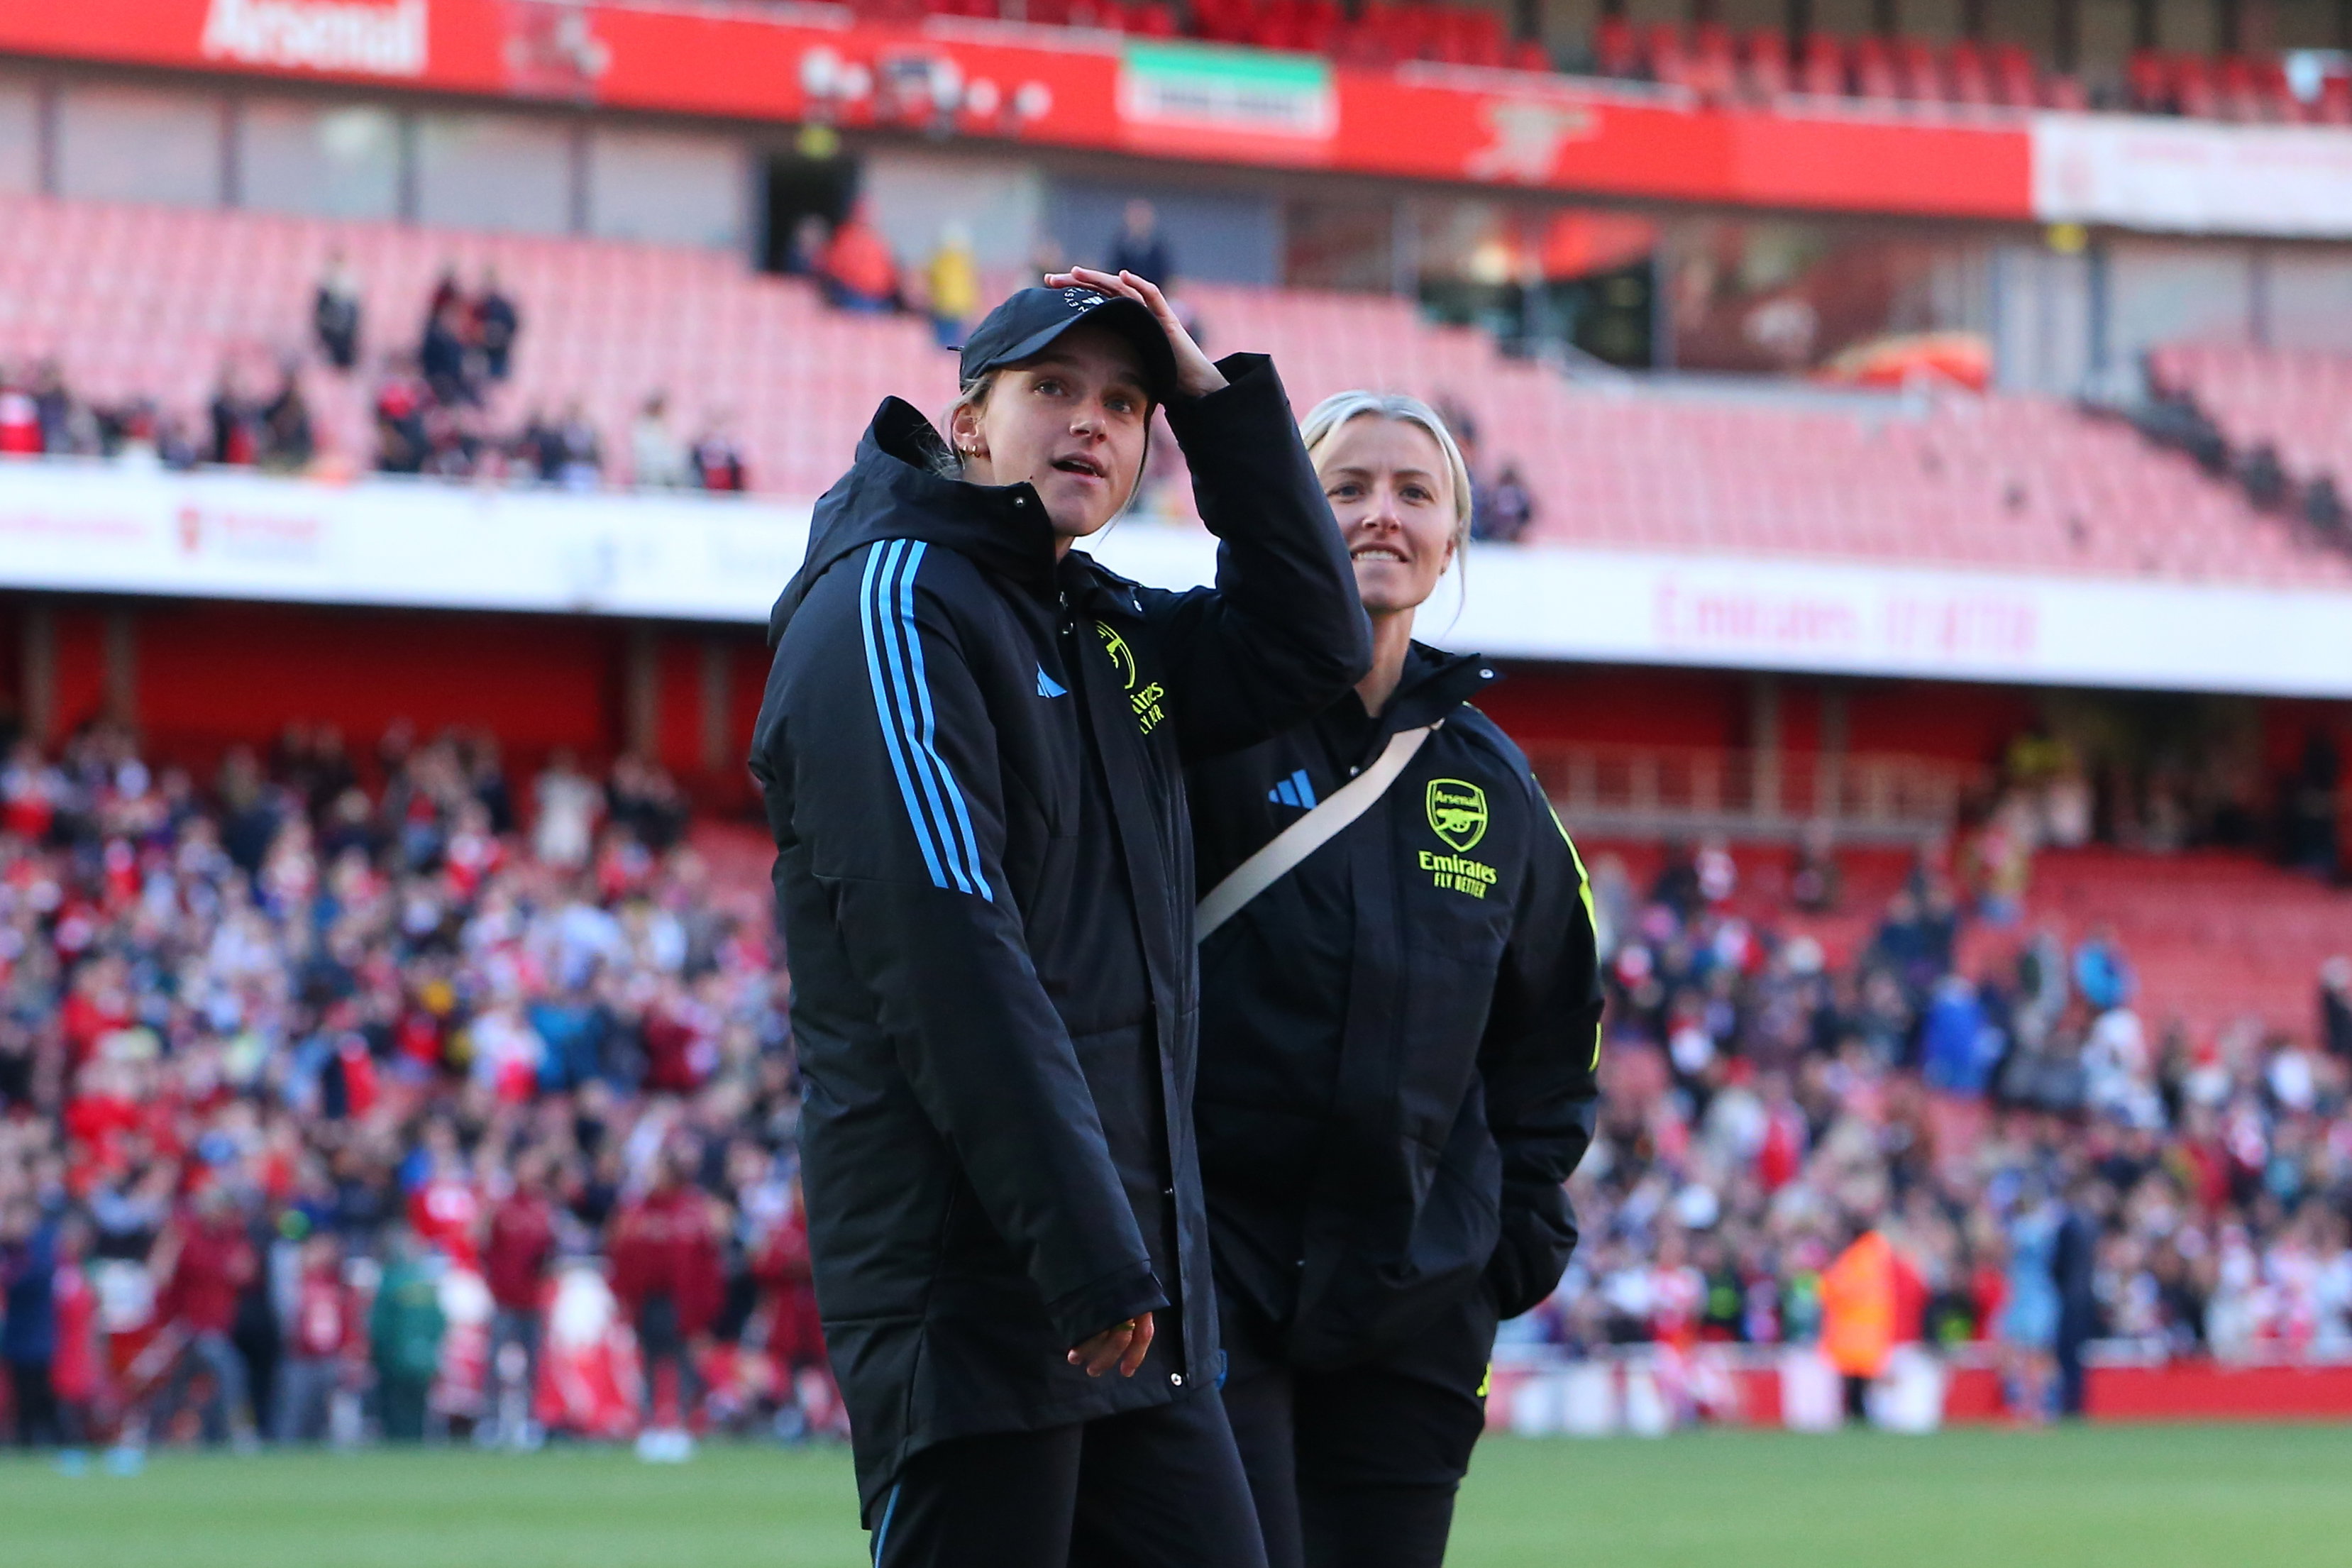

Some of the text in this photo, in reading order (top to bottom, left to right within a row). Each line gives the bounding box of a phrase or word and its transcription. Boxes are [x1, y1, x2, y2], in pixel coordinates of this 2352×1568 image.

[1435, 790, 1479, 807] Arsenal
[1419, 851, 1497, 884] Emirates
[1434, 872, 1486, 899] FLY BETTER
